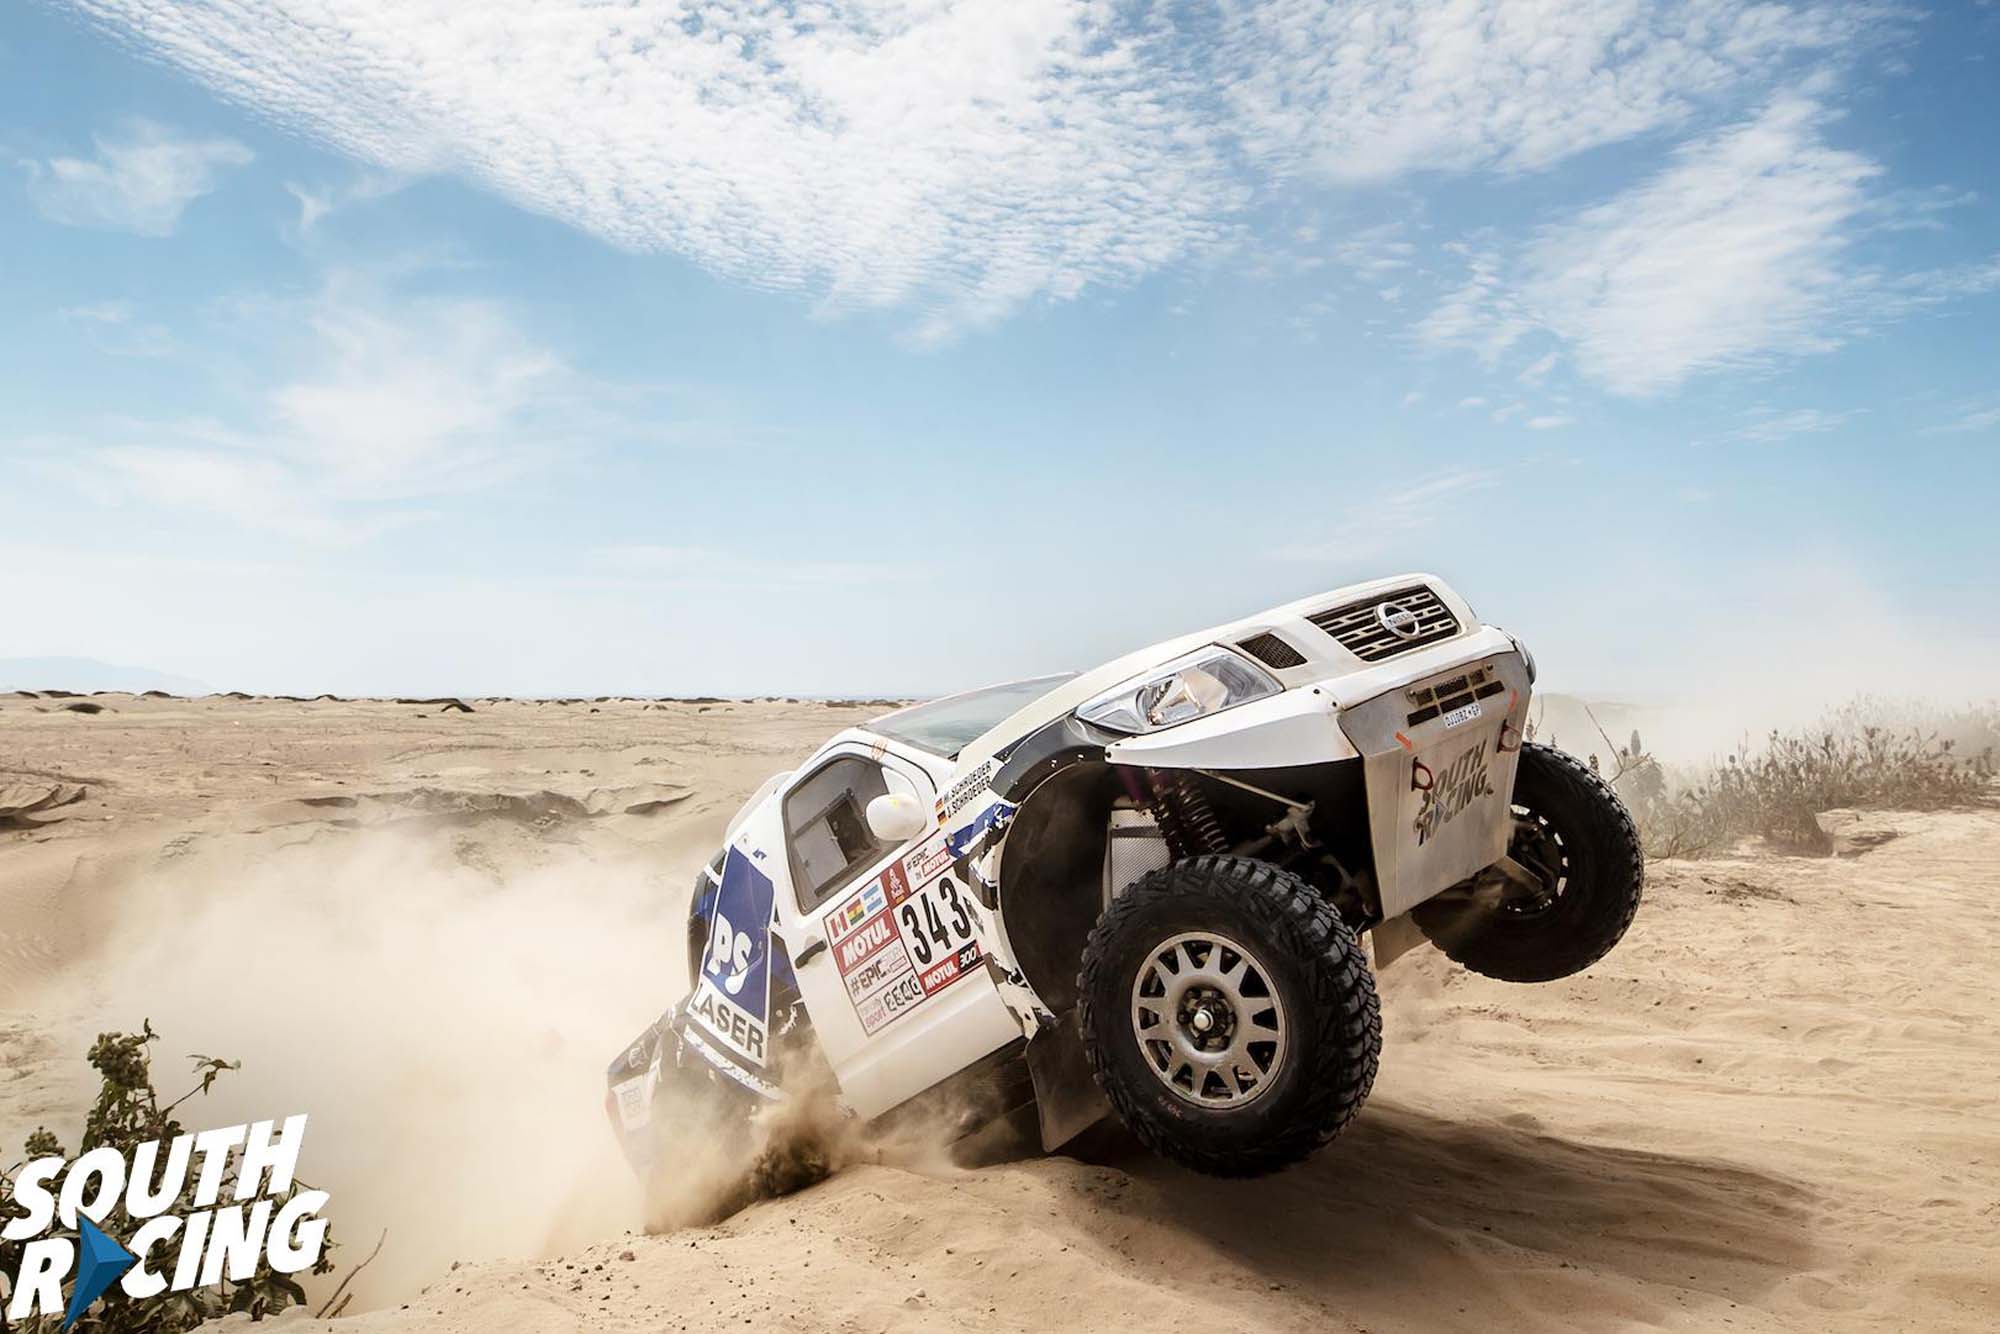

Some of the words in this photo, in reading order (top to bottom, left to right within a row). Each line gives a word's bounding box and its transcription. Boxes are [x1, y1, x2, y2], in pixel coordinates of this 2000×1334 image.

[706, 912, 753, 996] PS
[842, 915, 891, 968] MOTUL
[901, 876, 971, 965] 343
[924, 960, 958, 991] MOTUL
[691, 983, 764, 1058] LASER
